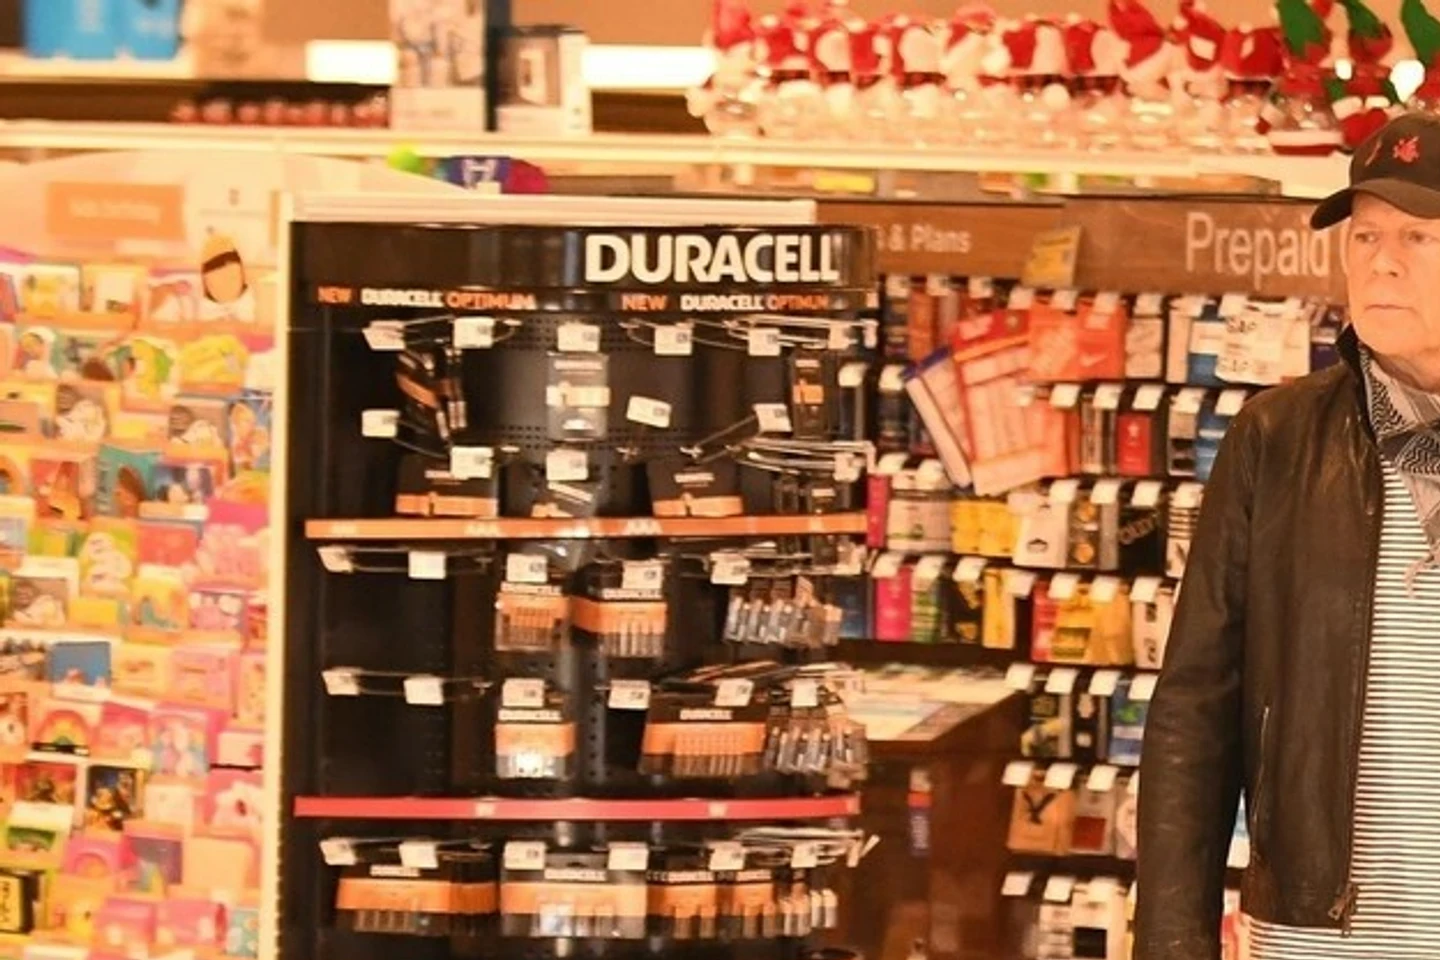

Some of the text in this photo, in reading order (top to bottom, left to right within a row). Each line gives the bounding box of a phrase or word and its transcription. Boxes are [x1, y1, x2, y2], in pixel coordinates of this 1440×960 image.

[911, 223, 972, 253] Plans
[1185, 211, 1331, 291] Prepaid
[585, 234, 840, 283] DURACELL
[317, 286, 537, 310] NEW DURACELL OPTIMUM
[621, 295, 667, 311] NEW
[680, 294, 765, 311] DURACELL
